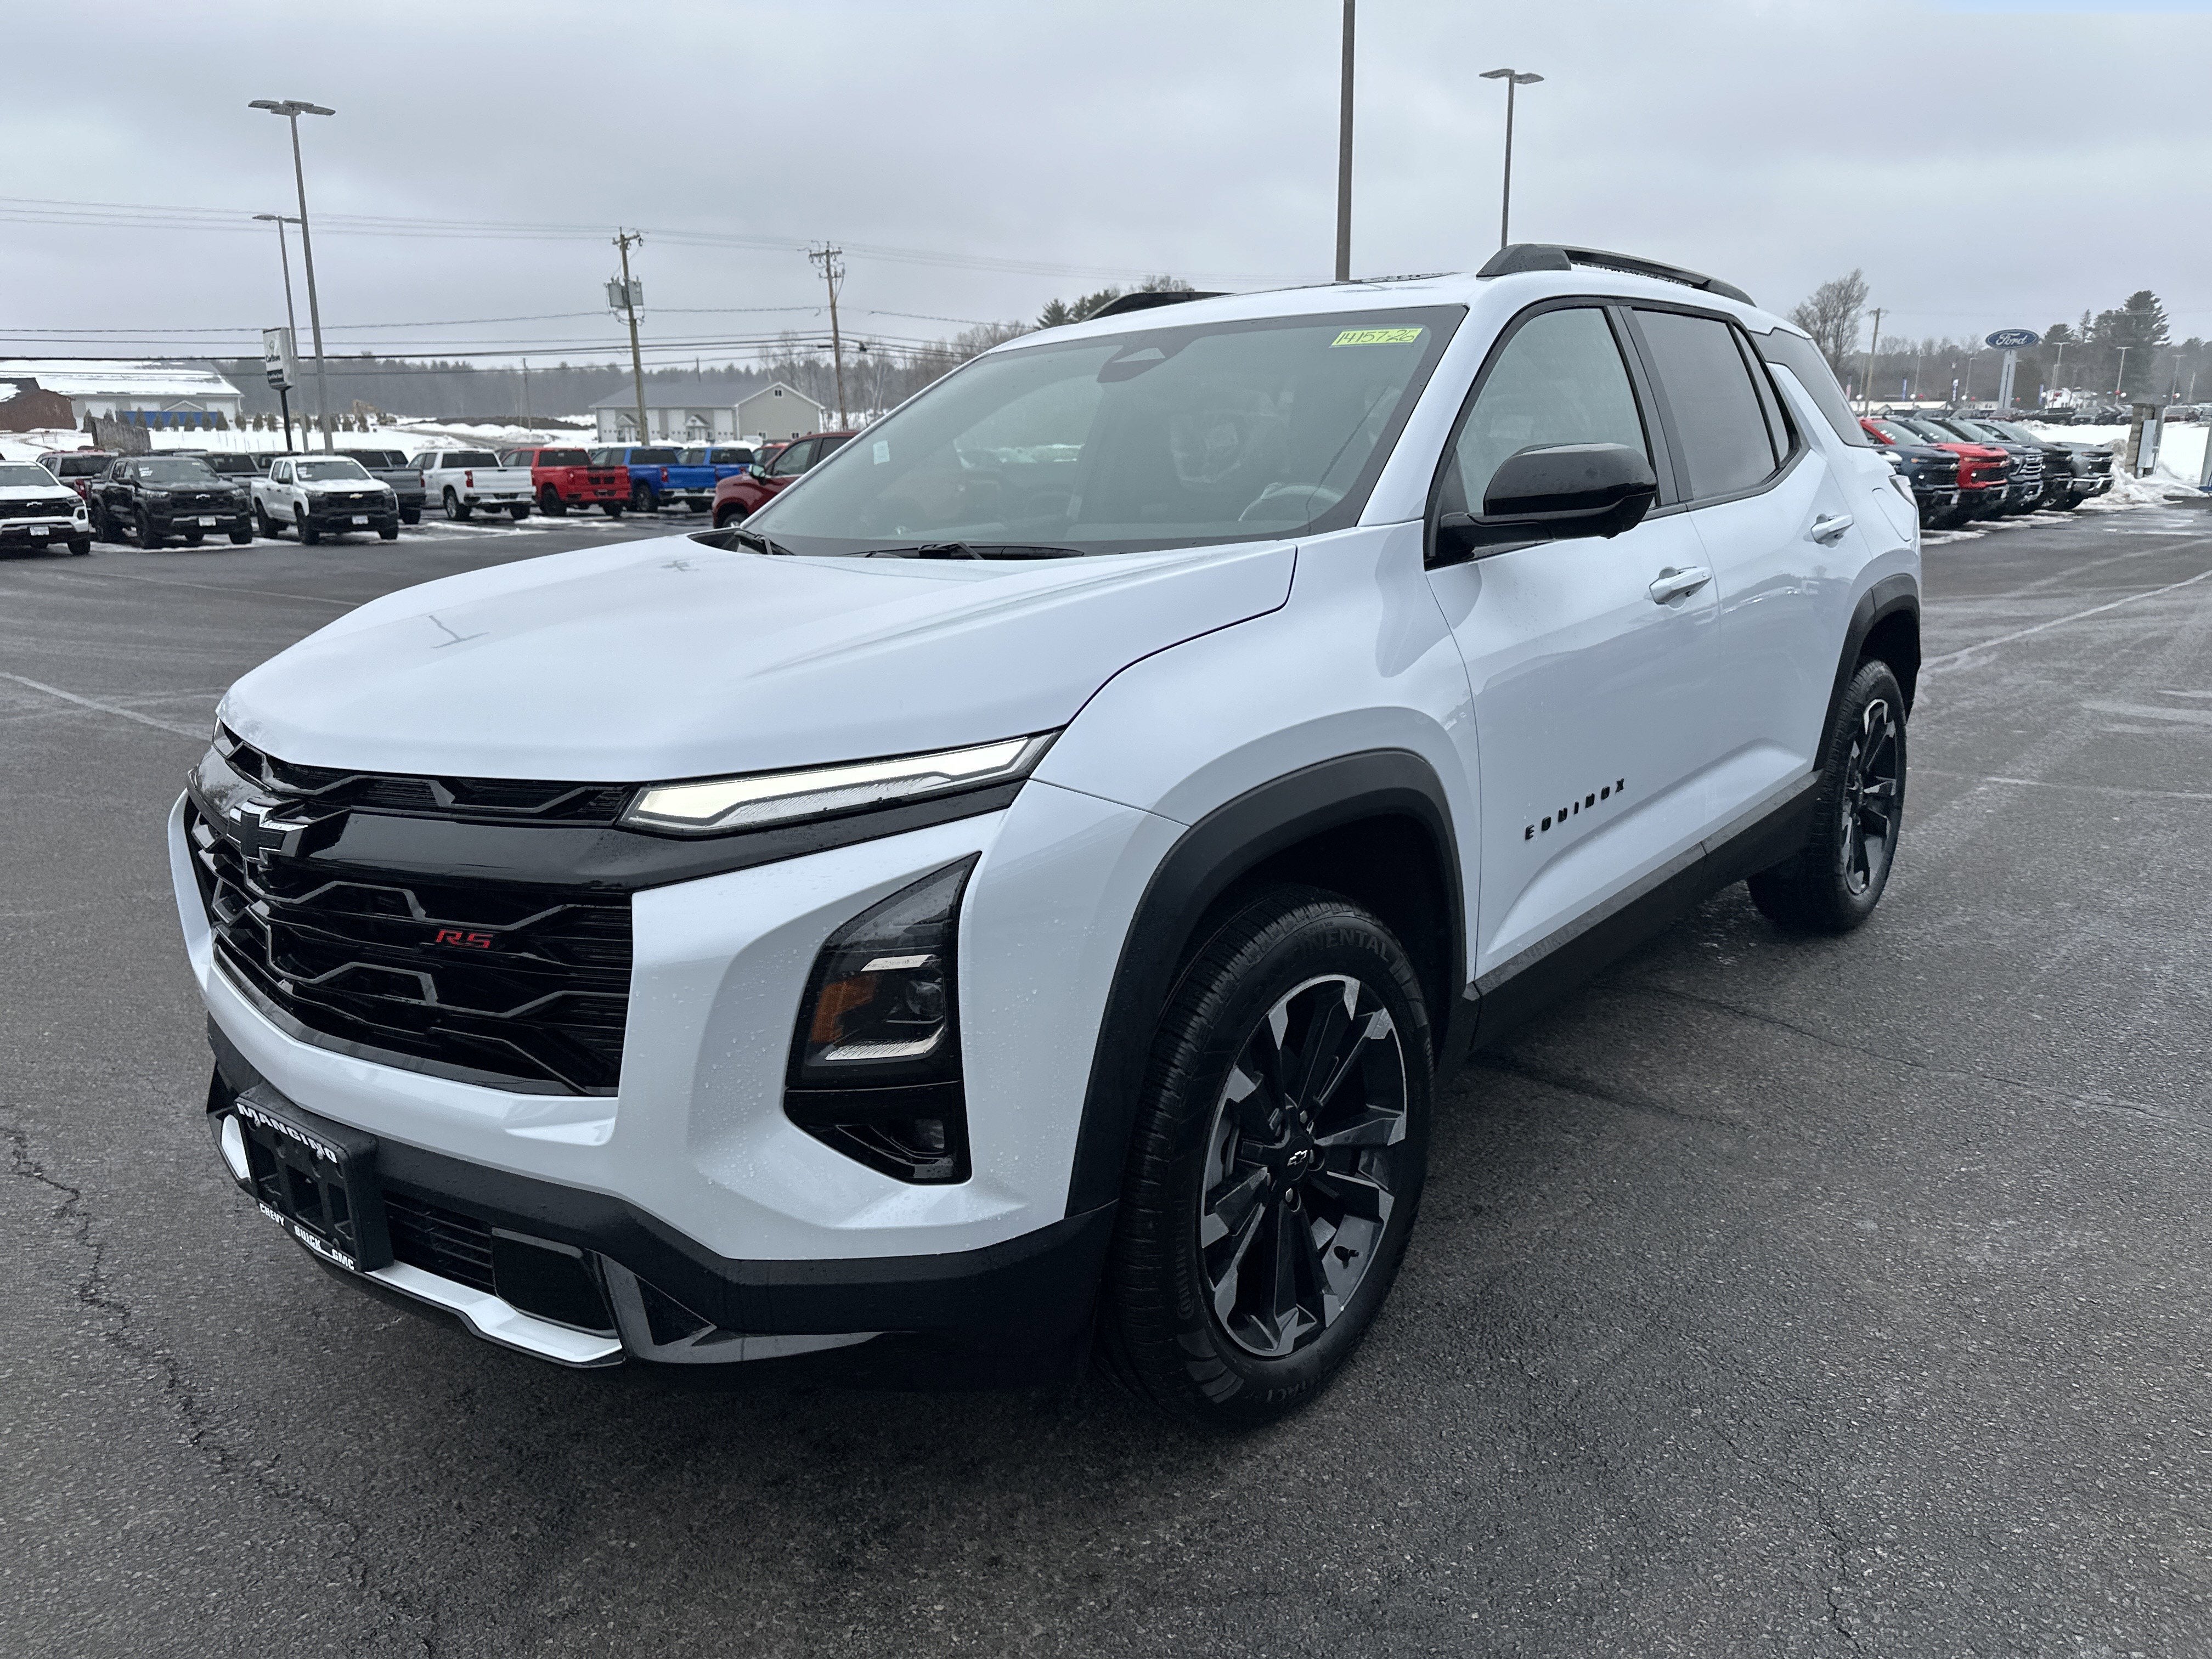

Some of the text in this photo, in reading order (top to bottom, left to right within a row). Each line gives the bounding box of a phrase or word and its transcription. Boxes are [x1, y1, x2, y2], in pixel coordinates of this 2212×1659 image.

[1335, 329, 1418, 345] 14157-26
[1995, 332, 2029, 346] Ford
[1525, 777, 1625, 840] EQUINOX
[436, 929, 493, 949] RS
[236, 1103, 337, 1163] MANGINO
[259, 1203, 355, 1271] CHEVY BUICK GMC
